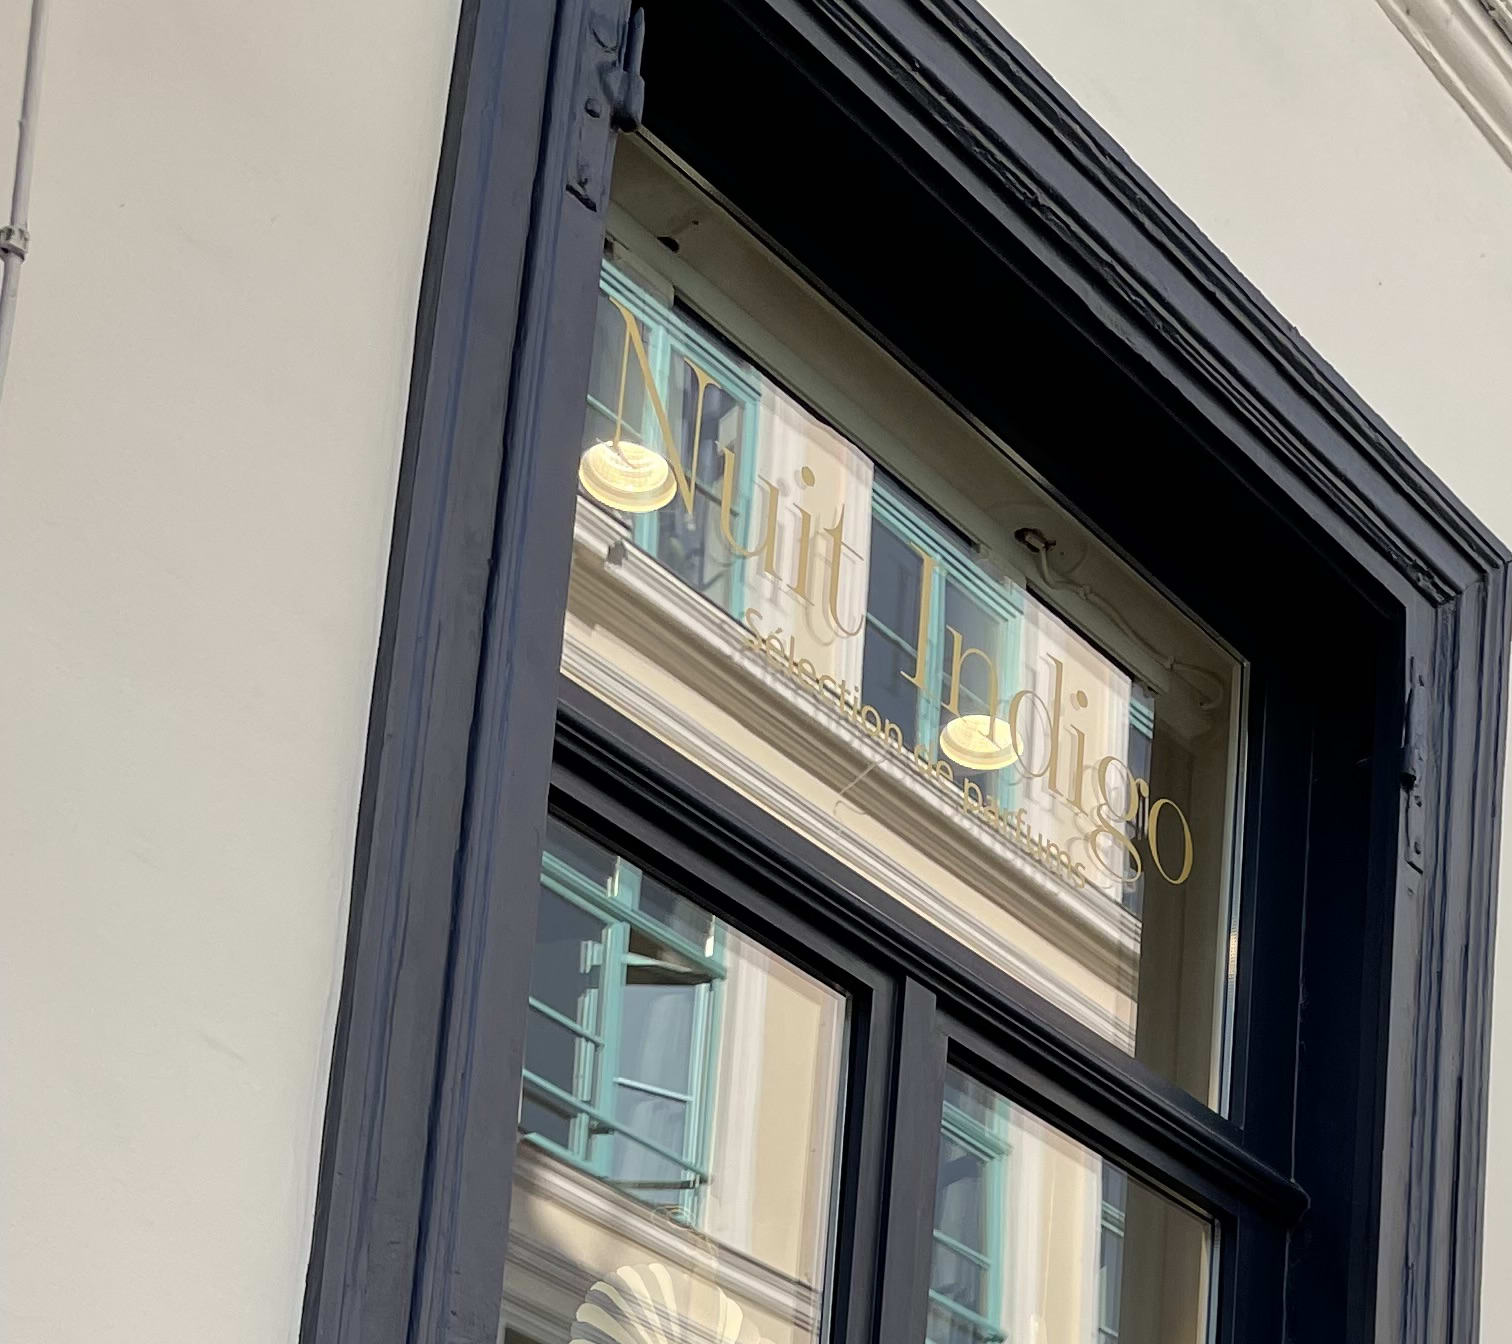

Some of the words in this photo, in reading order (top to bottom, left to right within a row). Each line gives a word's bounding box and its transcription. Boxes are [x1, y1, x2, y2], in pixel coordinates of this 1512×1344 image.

[597, 296, 865, 637] Nuit
[899, 541, 1193, 885] Indigo
[743, 607, 904, 756] Sélection
[914, 744, 955, 784] de
[963, 777, 1086, 889] parfums
